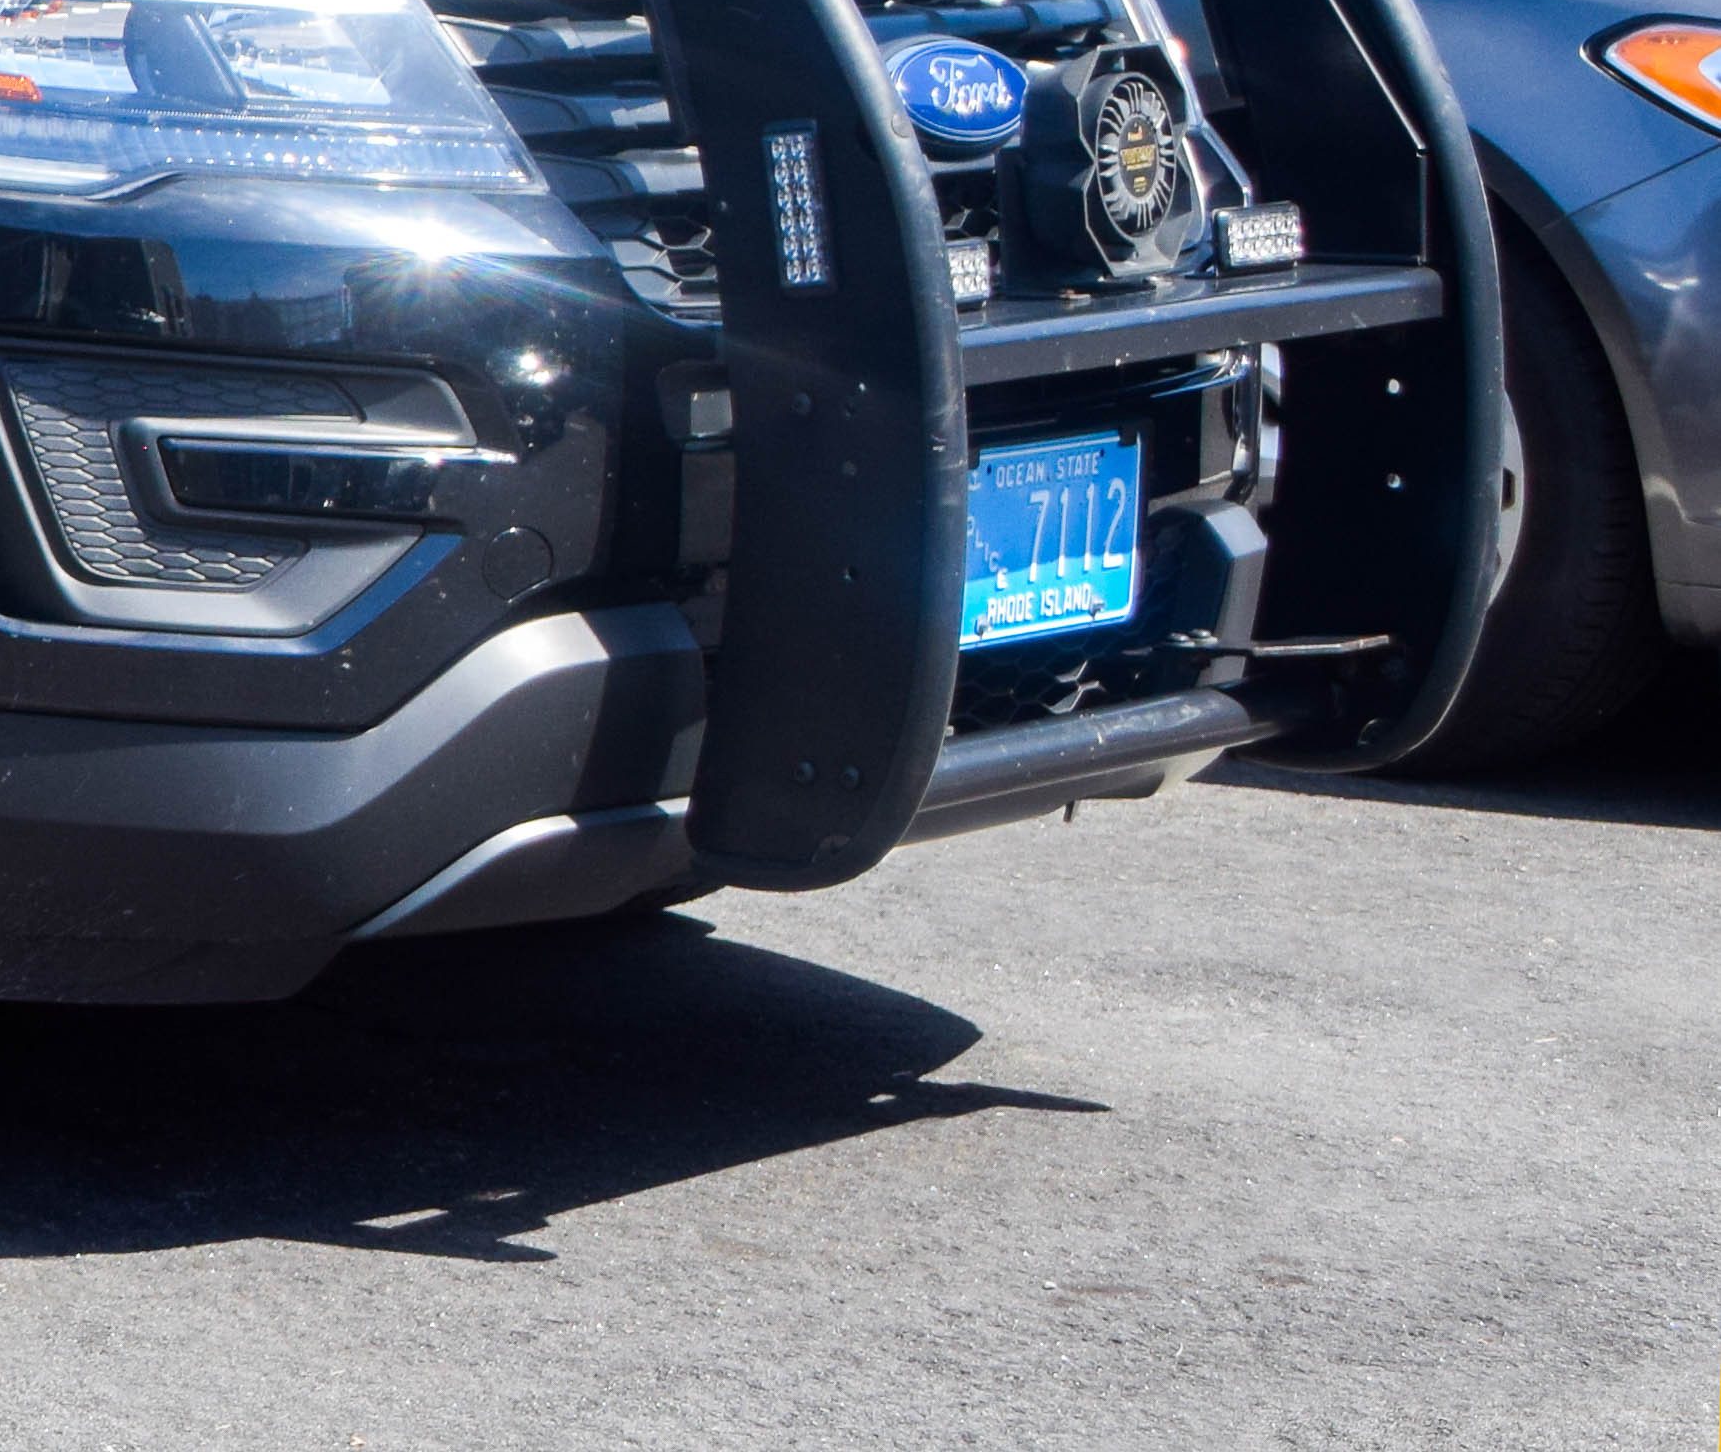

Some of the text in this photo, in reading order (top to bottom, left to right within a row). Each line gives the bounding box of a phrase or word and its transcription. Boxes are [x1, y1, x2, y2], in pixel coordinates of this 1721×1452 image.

[929, 54, 1013, 114] Ford
[996, 452, 1101, 489] OCEAN STATE
[966, 514, 1009, 589] OLICE
[1027, 476, 1127, 584] 7112
[987, 583, 1092, 625] RHODE ISLAND
